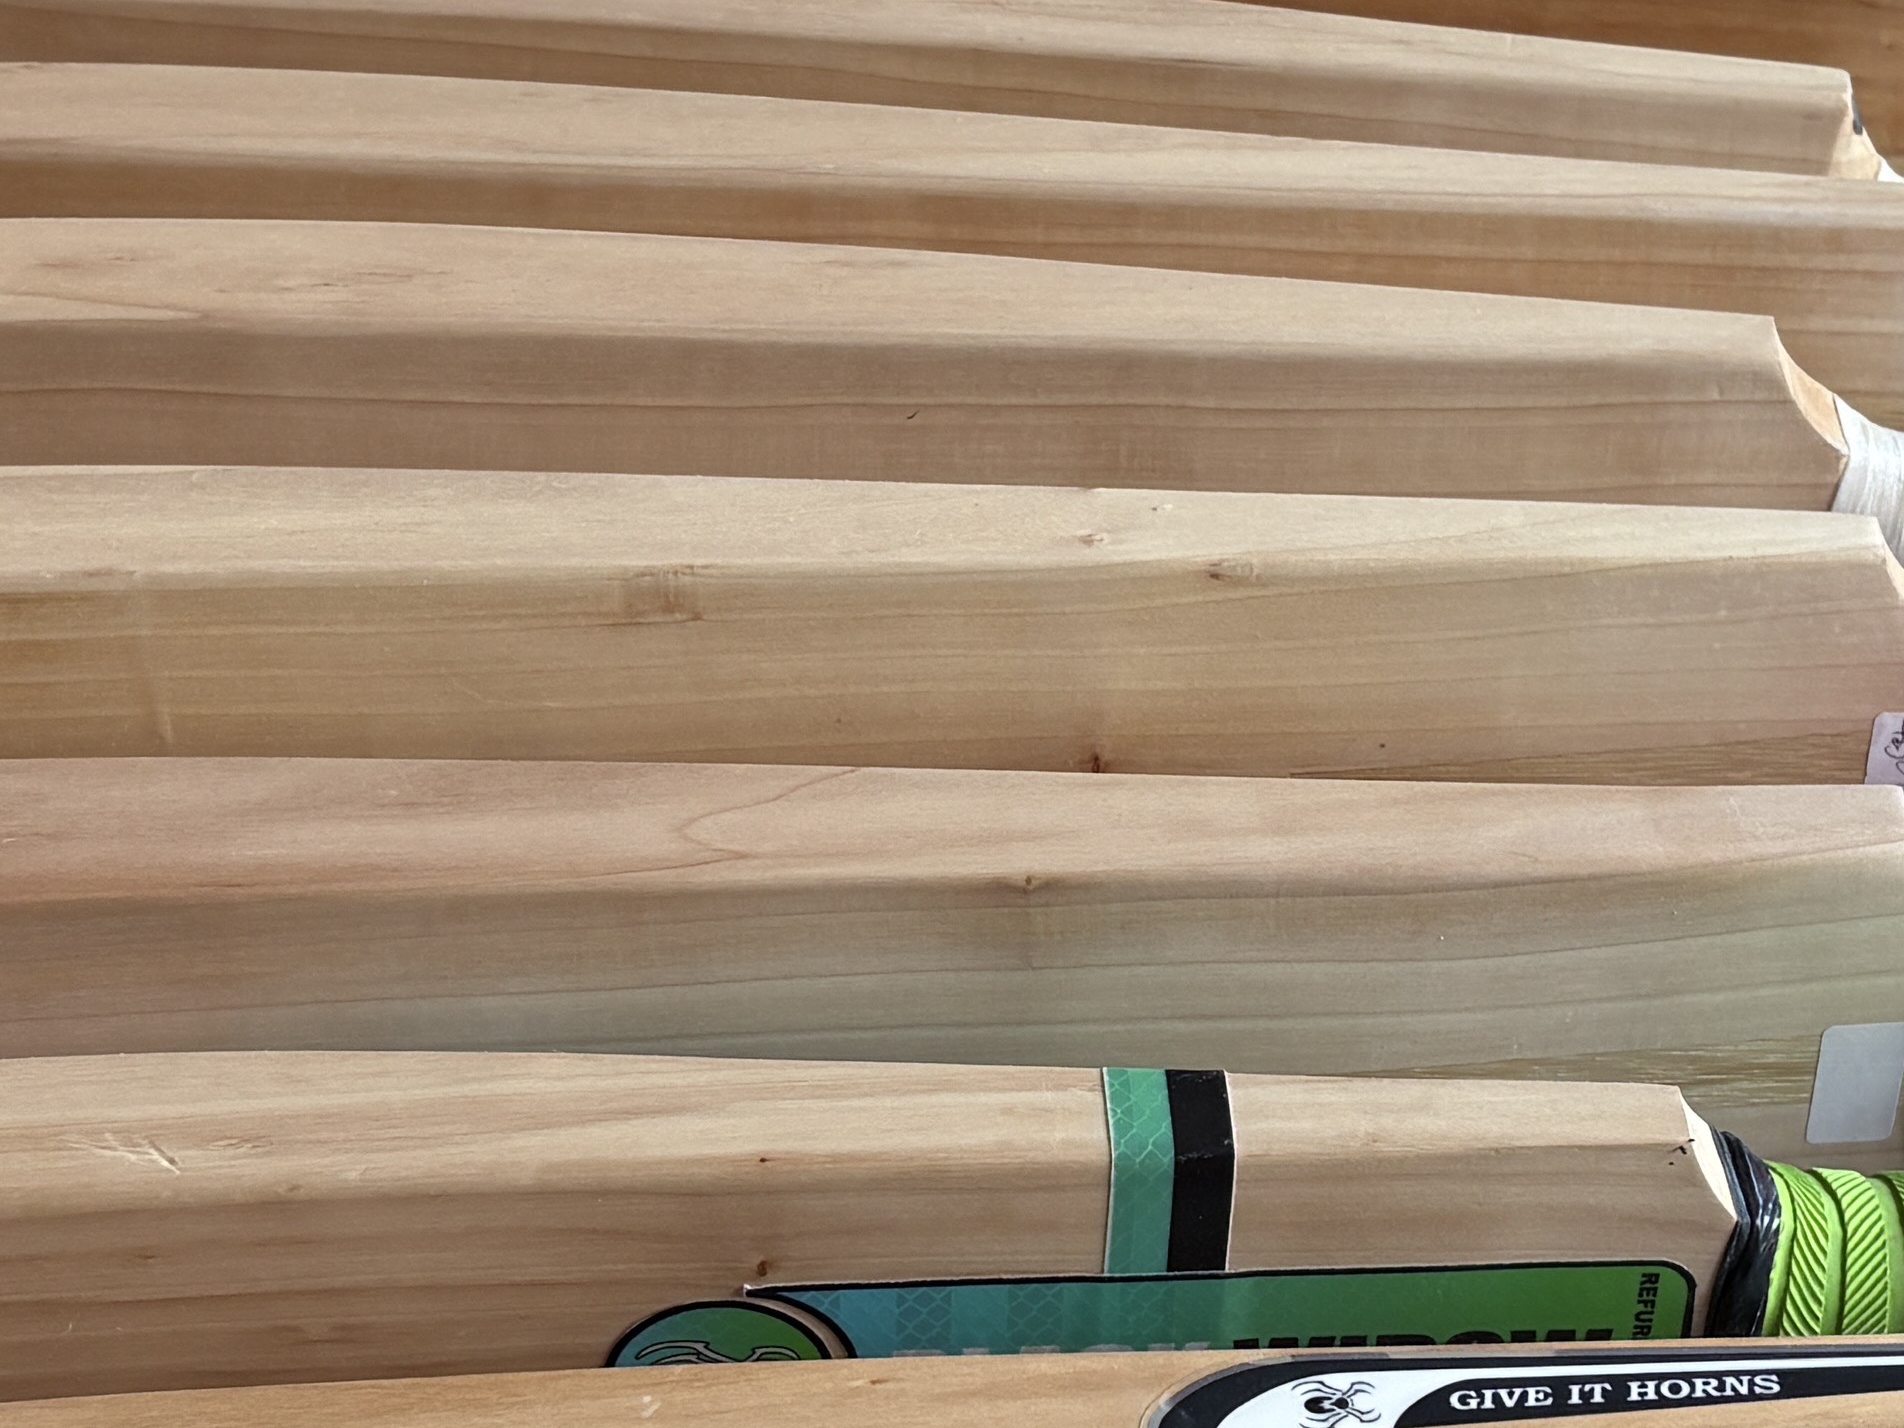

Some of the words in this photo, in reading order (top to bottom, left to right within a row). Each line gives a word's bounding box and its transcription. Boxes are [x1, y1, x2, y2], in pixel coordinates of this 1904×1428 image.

[1631, 1272, 1661, 1340] REFUR
[1449, 1385, 1554, 1411] GIVE
[1567, 1381, 1613, 1405] IT
[1627, 1374, 1782, 1402] HORNS
